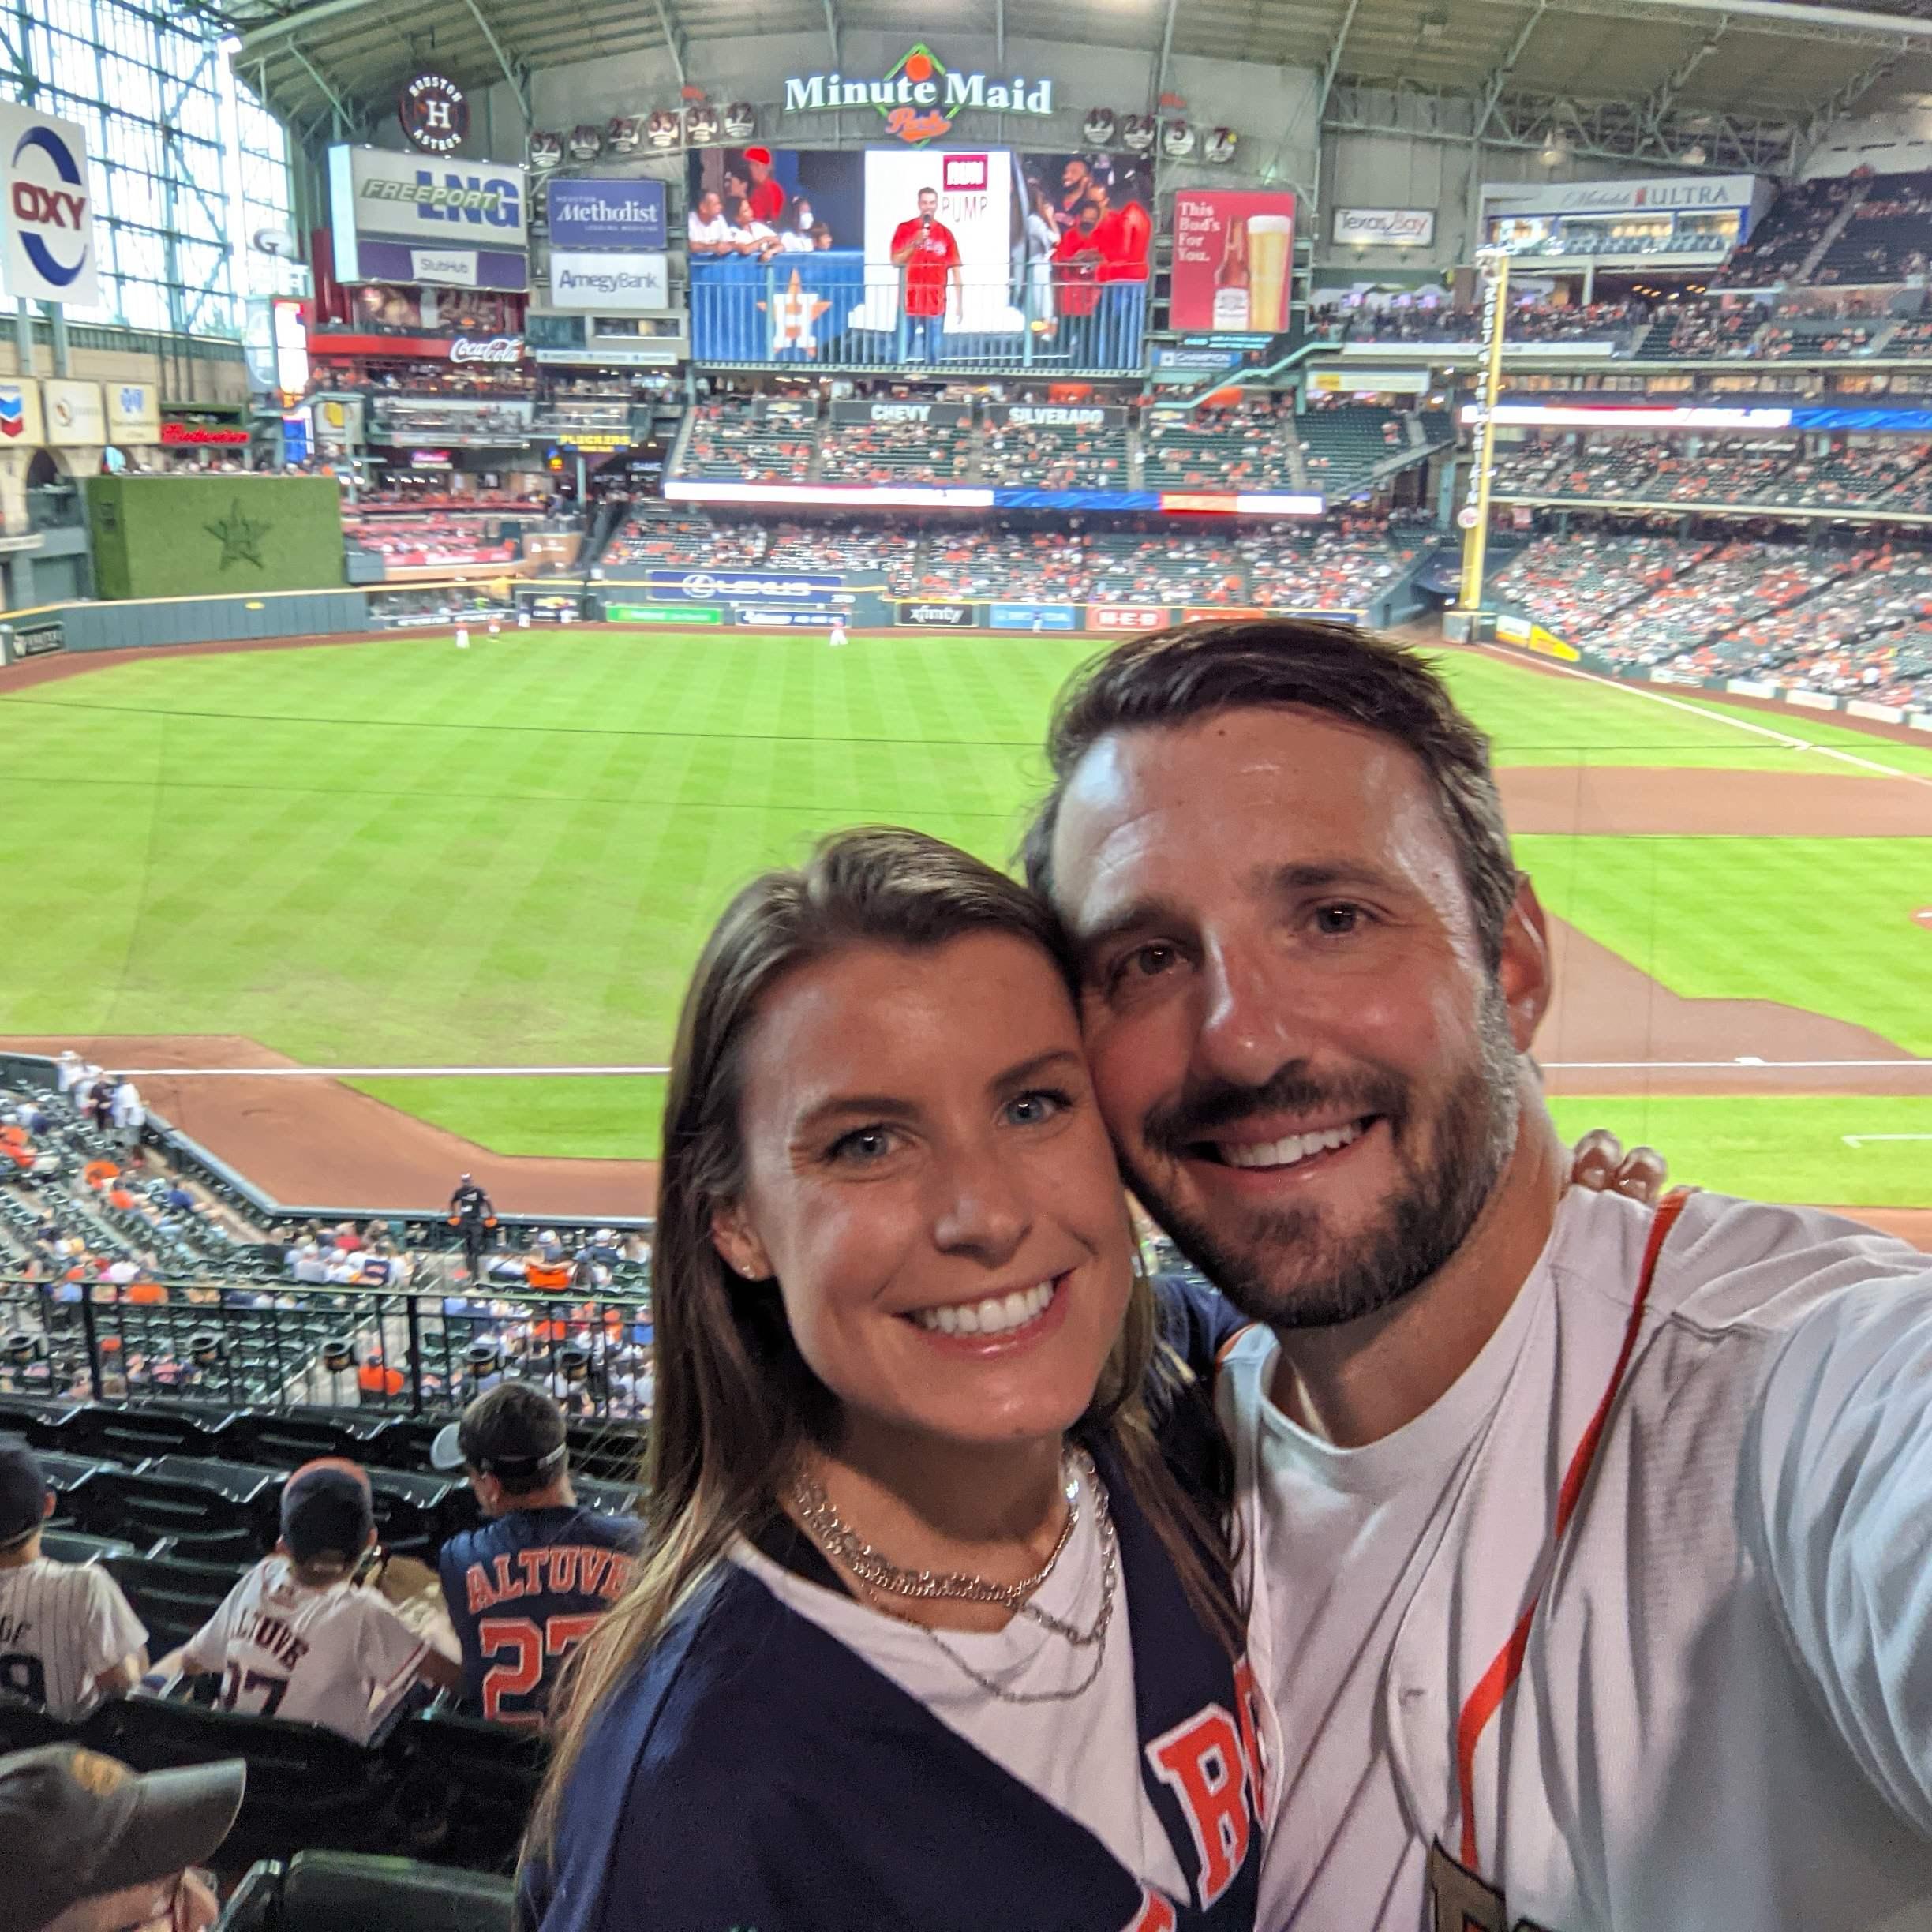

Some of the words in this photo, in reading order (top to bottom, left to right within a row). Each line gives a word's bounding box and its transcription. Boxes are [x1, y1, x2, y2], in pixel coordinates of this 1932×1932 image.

[409, 77, 462, 102] HOUSTON
[784, 74, 937, 110] Minute
[945, 73, 1053, 114] Maid
[426, 100, 451, 129] H
[414, 129, 462, 151] ASTROS
[1214, 126, 1230, 148] 7
[12, 182, 86, 231] OXY
[365, 181, 498, 210] FREEPORT
[417, 170, 520, 227] LNG
[1651, 186, 1729, 205] ULTRA
[556, 200, 658, 223] Methodist
[942, 196, 988, 223] PUMP
[1178, 202, 1214, 217] This
[1178, 217, 1221, 232] Bud's
[1178, 232, 1205, 247] For
[1178, 247, 1211, 262] You.
[421, 258, 469, 274] StubHub
[871, 405, 931, 421] CHEVY
[1009, 406, 1105, 425] SILVERADO
[909, 605, 964, 624] xfinity
[1098, 611, 1159, 626] H-E-B
[465, 1544, 638, 1615] ALTUVE
